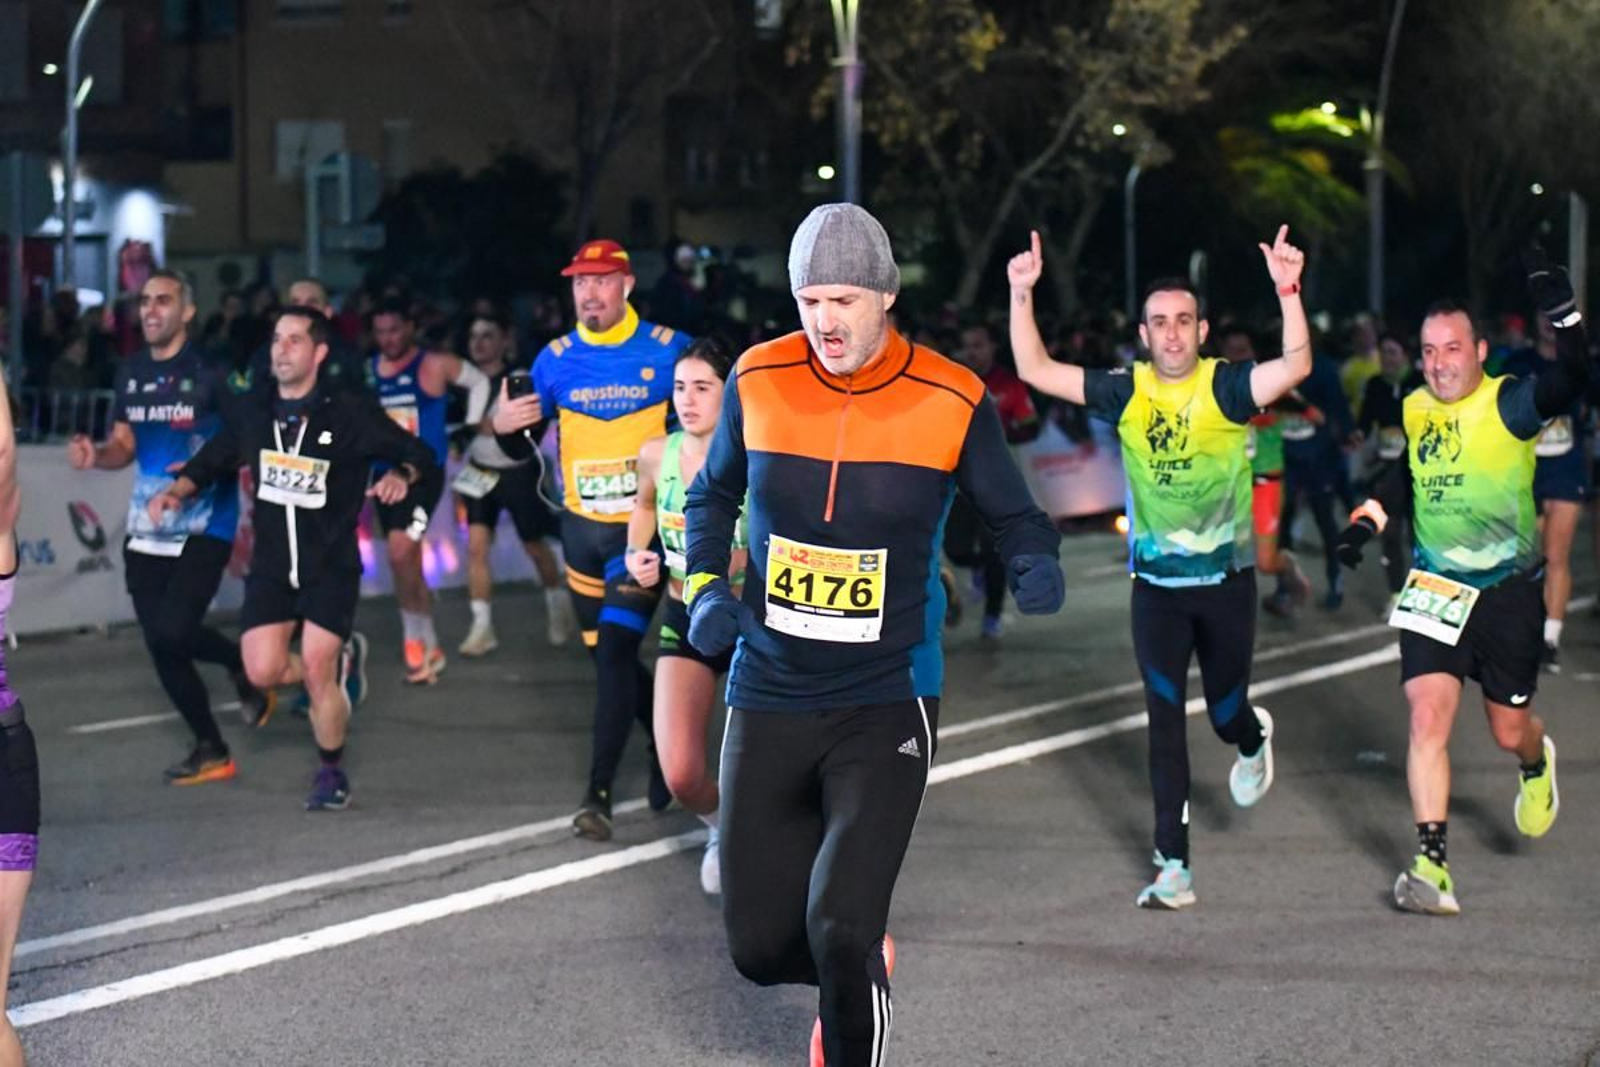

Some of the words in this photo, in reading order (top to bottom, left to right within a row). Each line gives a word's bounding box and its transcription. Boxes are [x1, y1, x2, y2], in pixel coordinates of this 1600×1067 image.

[570, 383, 649, 406] agustinos
[147, 401, 194, 422] ANTÓN
[266, 466, 319, 491] 8522
[581, 472, 637, 497] 2348
[774, 567, 873, 608] 4176
[1401, 587, 1463, 622] 2675
